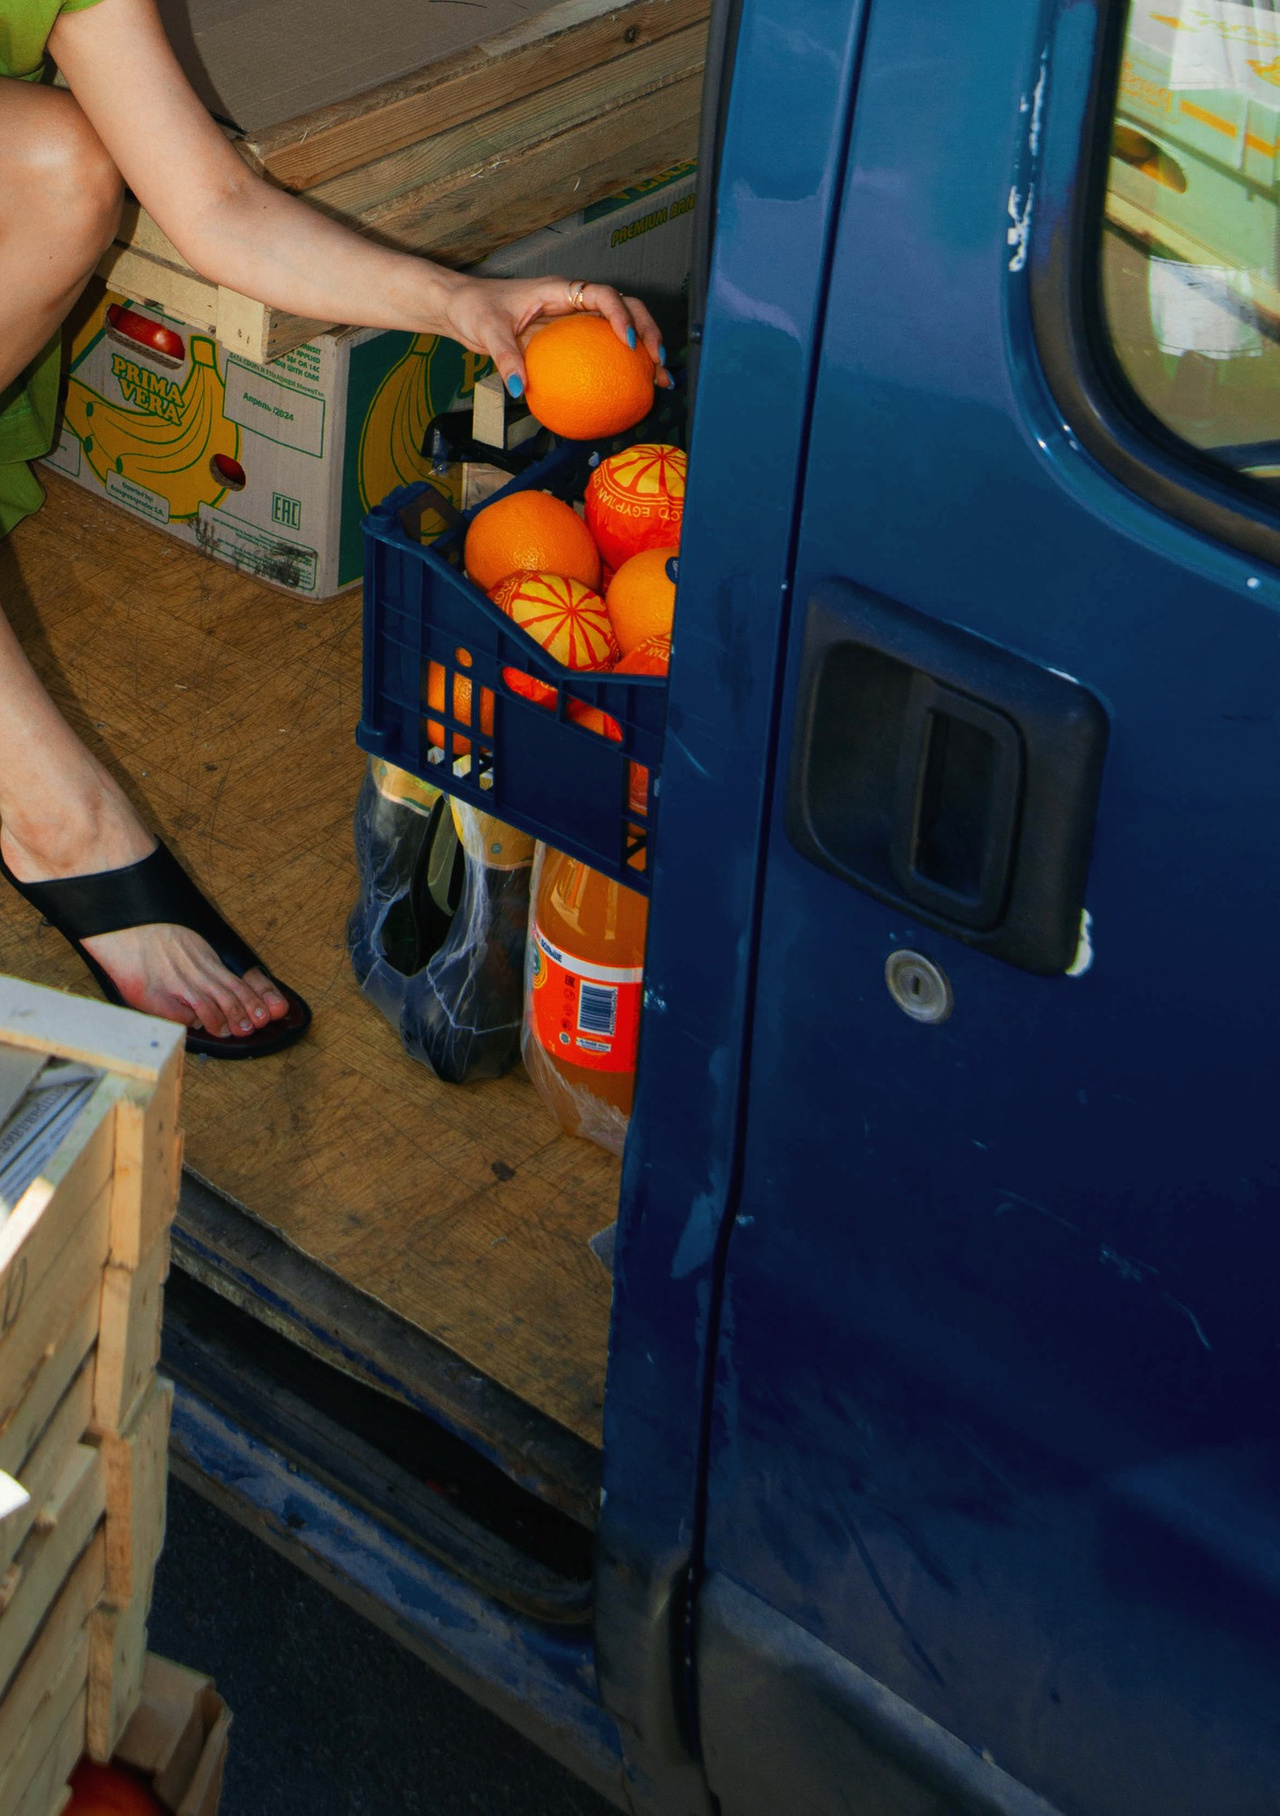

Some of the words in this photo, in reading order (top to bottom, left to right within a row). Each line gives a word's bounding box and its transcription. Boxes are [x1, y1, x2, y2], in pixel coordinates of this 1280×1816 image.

[611, 206, 668, 248] PREMIUM
[669, 193, 696, 220] BAN
[112, 352, 185, 408] PRIMA
[118, 376, 182, 427] VERA
[243, 392, 271, 412] Апрель
[597, 487, 650, 518] EGYPTIAN
